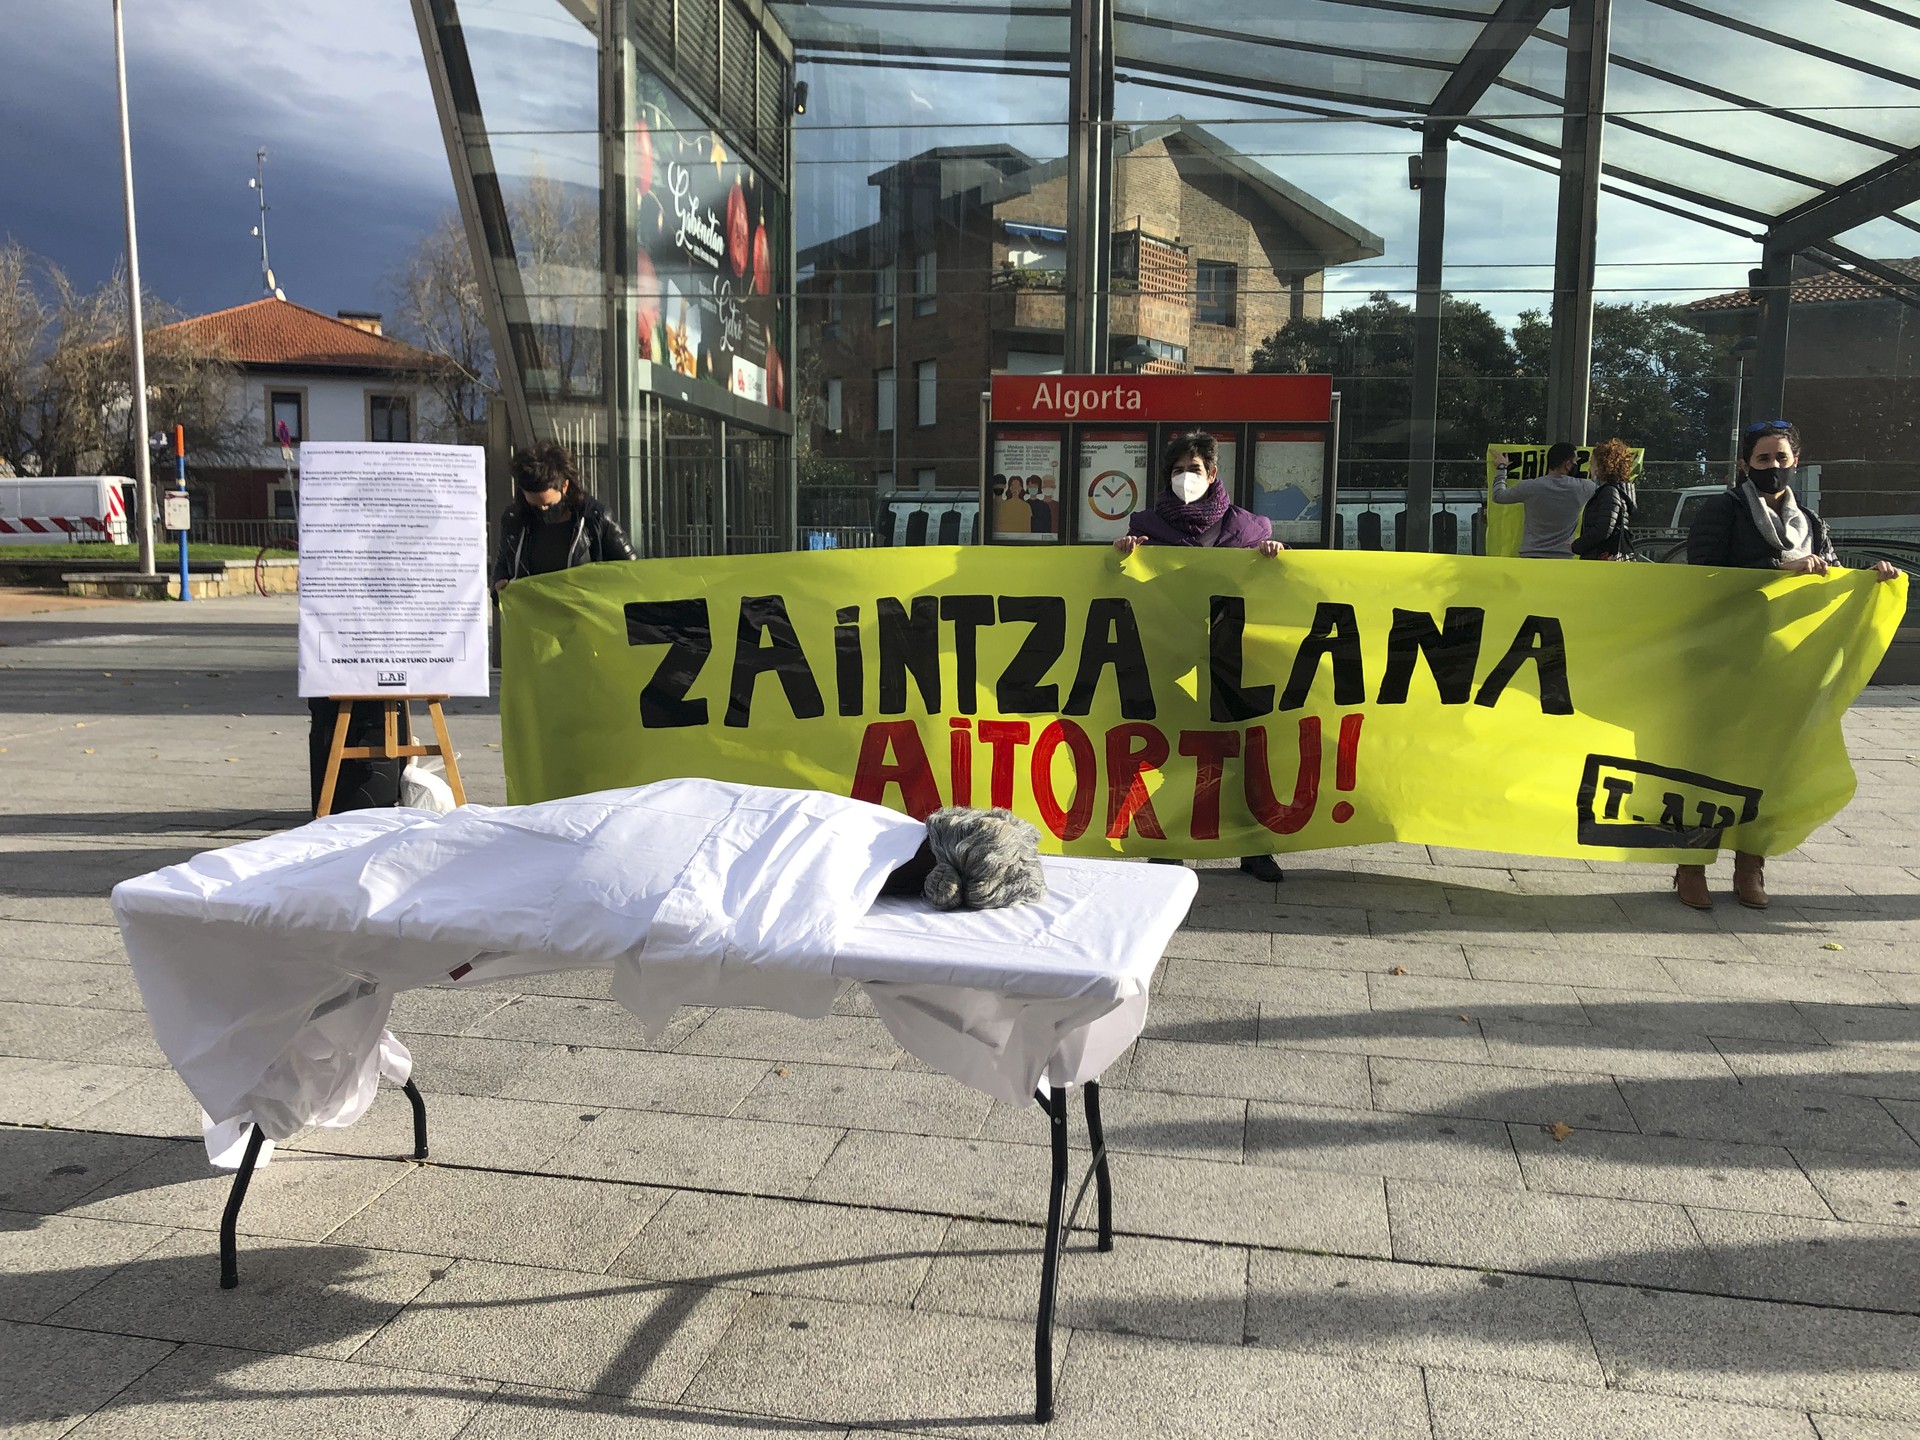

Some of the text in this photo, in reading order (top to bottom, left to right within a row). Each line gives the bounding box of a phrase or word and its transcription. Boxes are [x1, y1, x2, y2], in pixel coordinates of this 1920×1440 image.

[1031, 382, 1142, 418] Algorta
[379, 672, 405, 681] LAB
[1208, 595, 1575, 723] LANA
